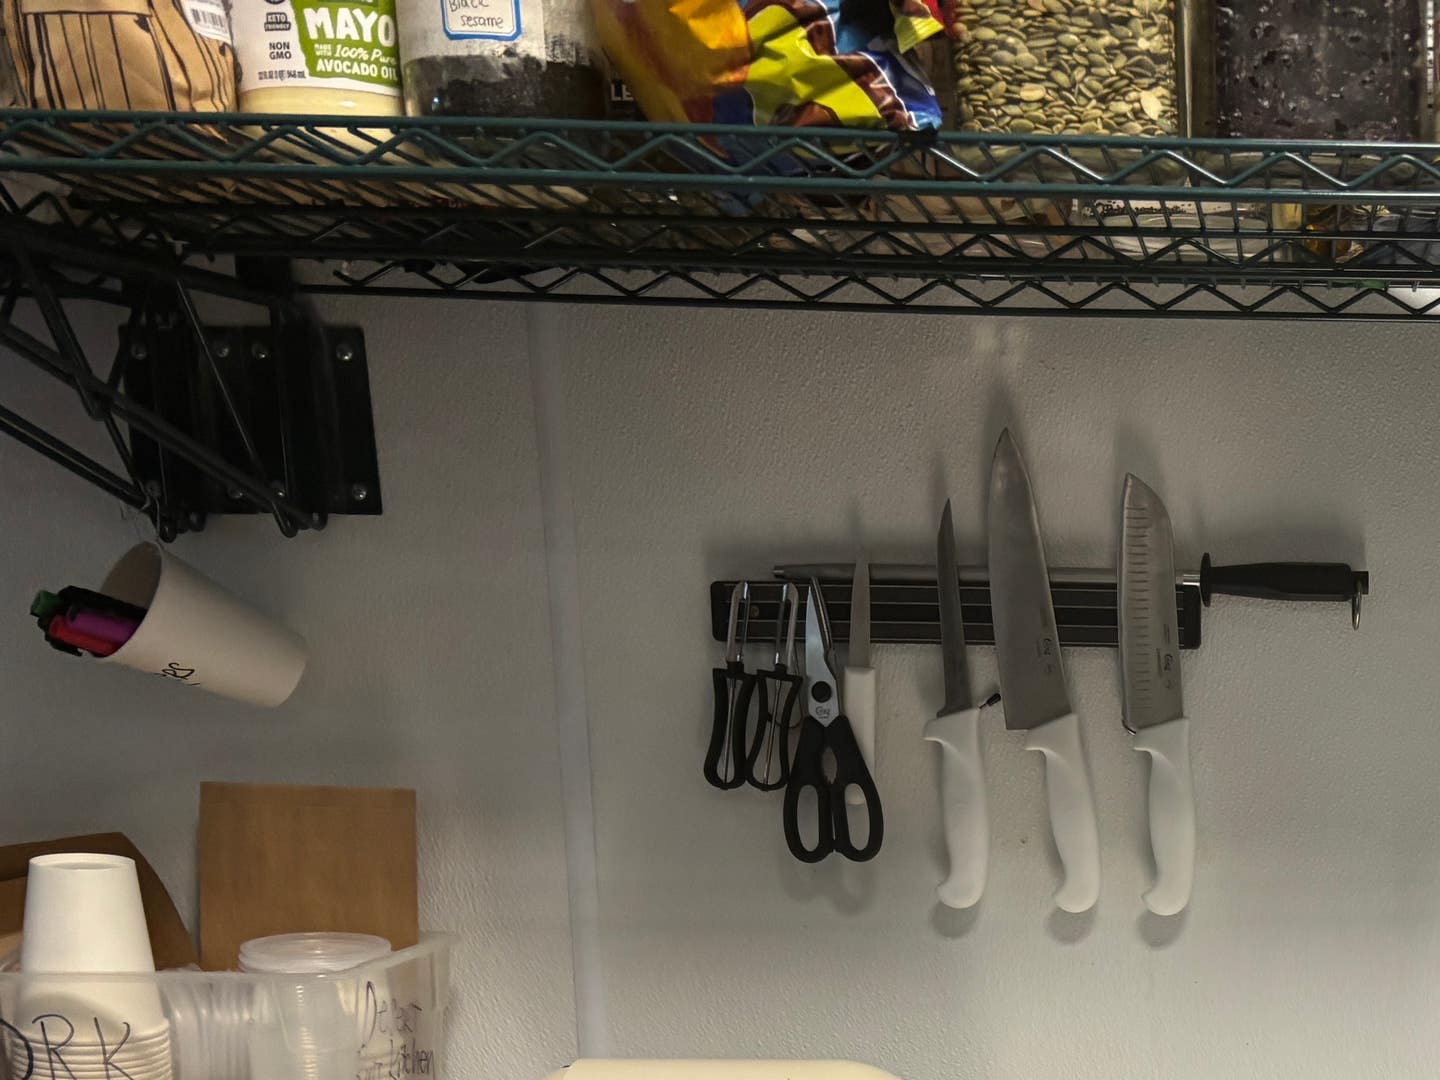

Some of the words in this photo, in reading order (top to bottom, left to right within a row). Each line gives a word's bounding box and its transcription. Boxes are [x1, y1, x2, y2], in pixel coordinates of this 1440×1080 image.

[267, 13, 287, 22] KETO
[461, 14, 504, 29] sesame
[303, 7, 395, 47] MAYO
[269, 42, 290, 50] NON
[334, 44, 369, 59] 100%
[269, 51, 292, 60] GMO
[317, 59, 378, 77] AVOCADO
[381, 66, 398, 80] OIL
